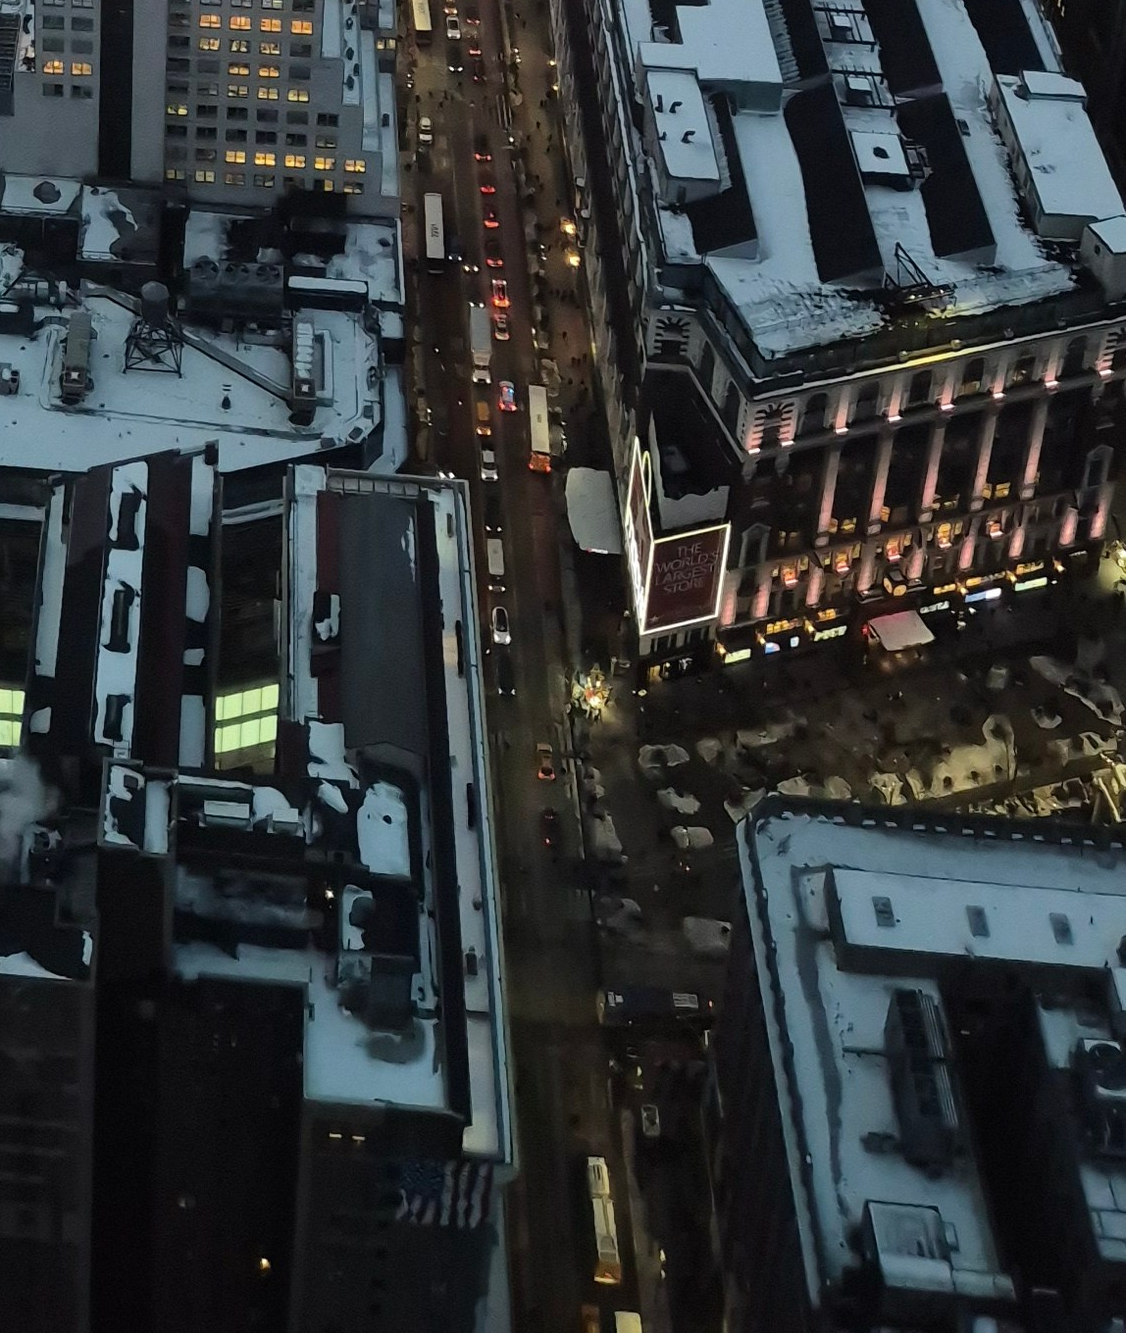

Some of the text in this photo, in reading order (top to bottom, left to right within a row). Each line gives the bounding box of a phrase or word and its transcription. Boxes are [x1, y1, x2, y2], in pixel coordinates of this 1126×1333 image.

[678, 542, 703, 558] THE
[656, 552, 719, 574] WORLDS
[655, 563, 714, 586] LARGEST
